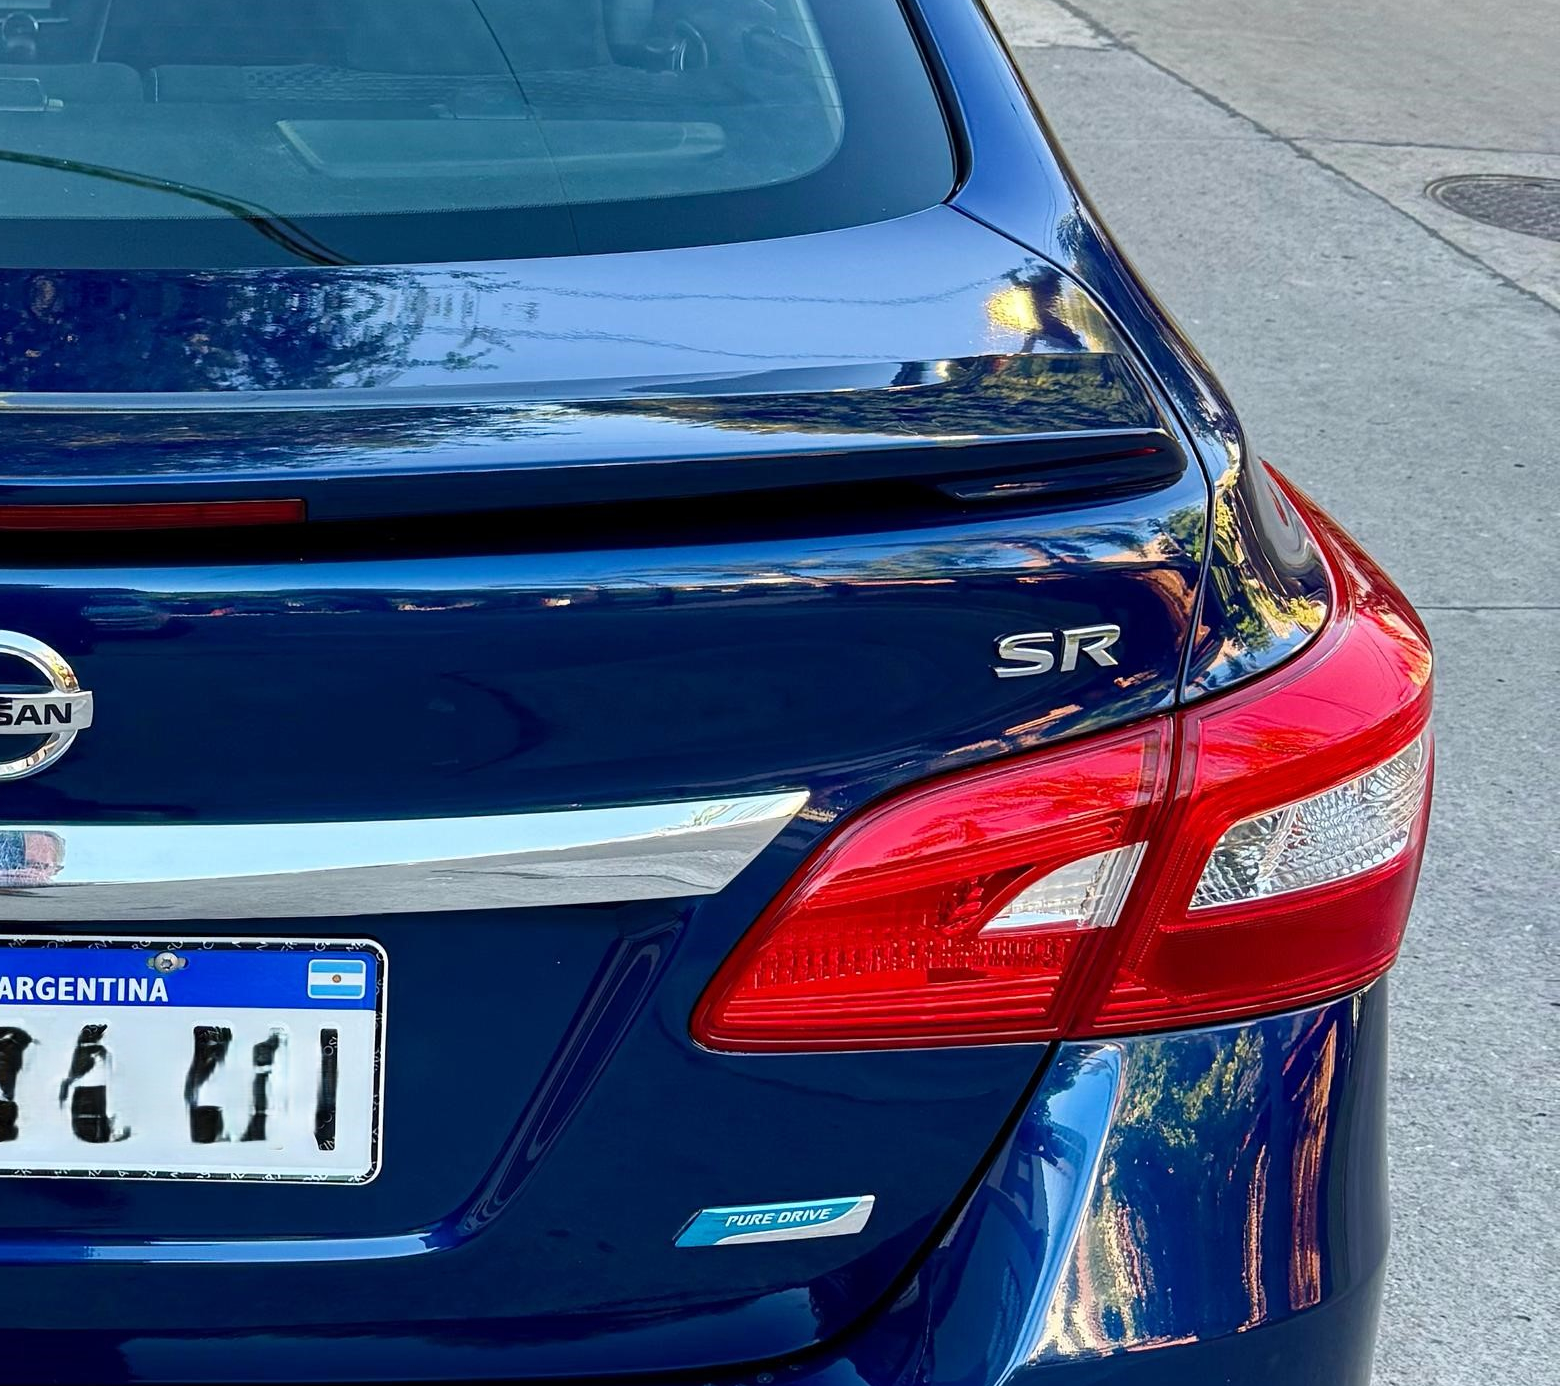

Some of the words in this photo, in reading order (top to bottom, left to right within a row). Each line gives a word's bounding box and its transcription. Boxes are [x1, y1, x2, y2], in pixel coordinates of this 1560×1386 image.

[993, 623, 1121, 678] SR
[725, 1212, 773, 1227] PURE
[777, 1207, 832, 1224] DRIVE
